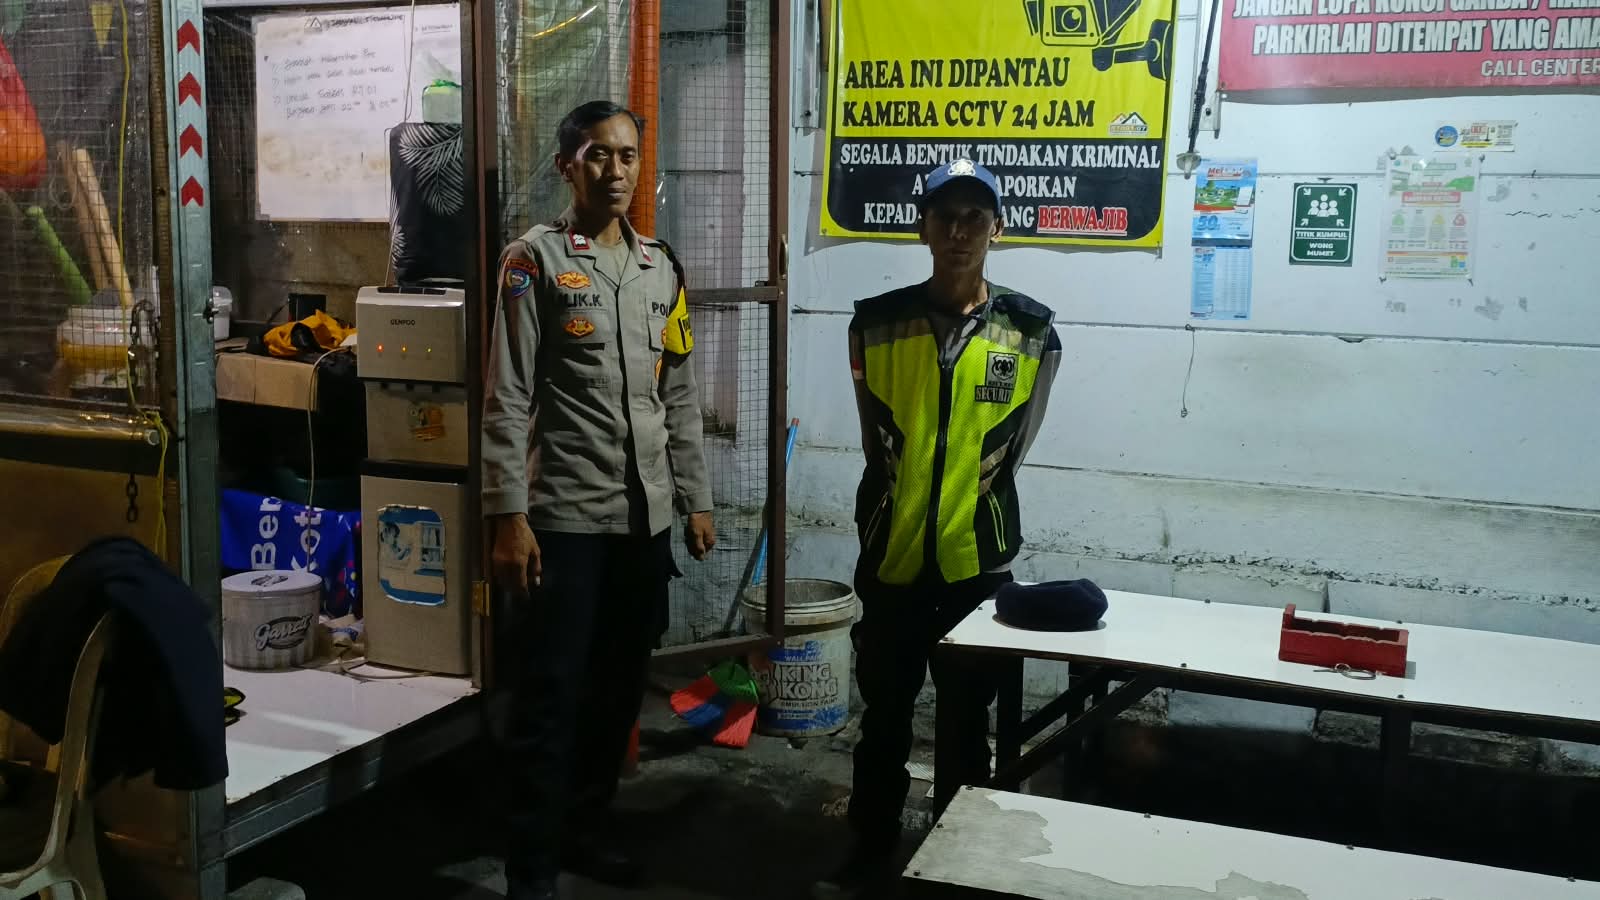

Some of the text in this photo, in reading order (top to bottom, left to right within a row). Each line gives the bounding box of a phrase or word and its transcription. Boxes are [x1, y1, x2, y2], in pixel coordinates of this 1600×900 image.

[1252, 22, 1373, 55] PARKIRLAH
[1375, 19, 1487, 53] DITEMPAT
[1490, 17, 1551, 51] YANG
[844, 56, 1071, 89] AREA INI DIPANTAU
[1481, 59, 1528, 77] CALL
[842, 100, 1096, 130] KAMERA CCTV 24 JAM
[840, 143, 1161, 169] SEGALA BENTUK TINDAKAN KRIMINAL
[995, 175, 1077, 198] APORKAN
[863, 202, 1128, 232] KEPAD ANG BERWAJIB
[780, 663, 831, 681] KING
[781, 677, 838, 701] KONG
